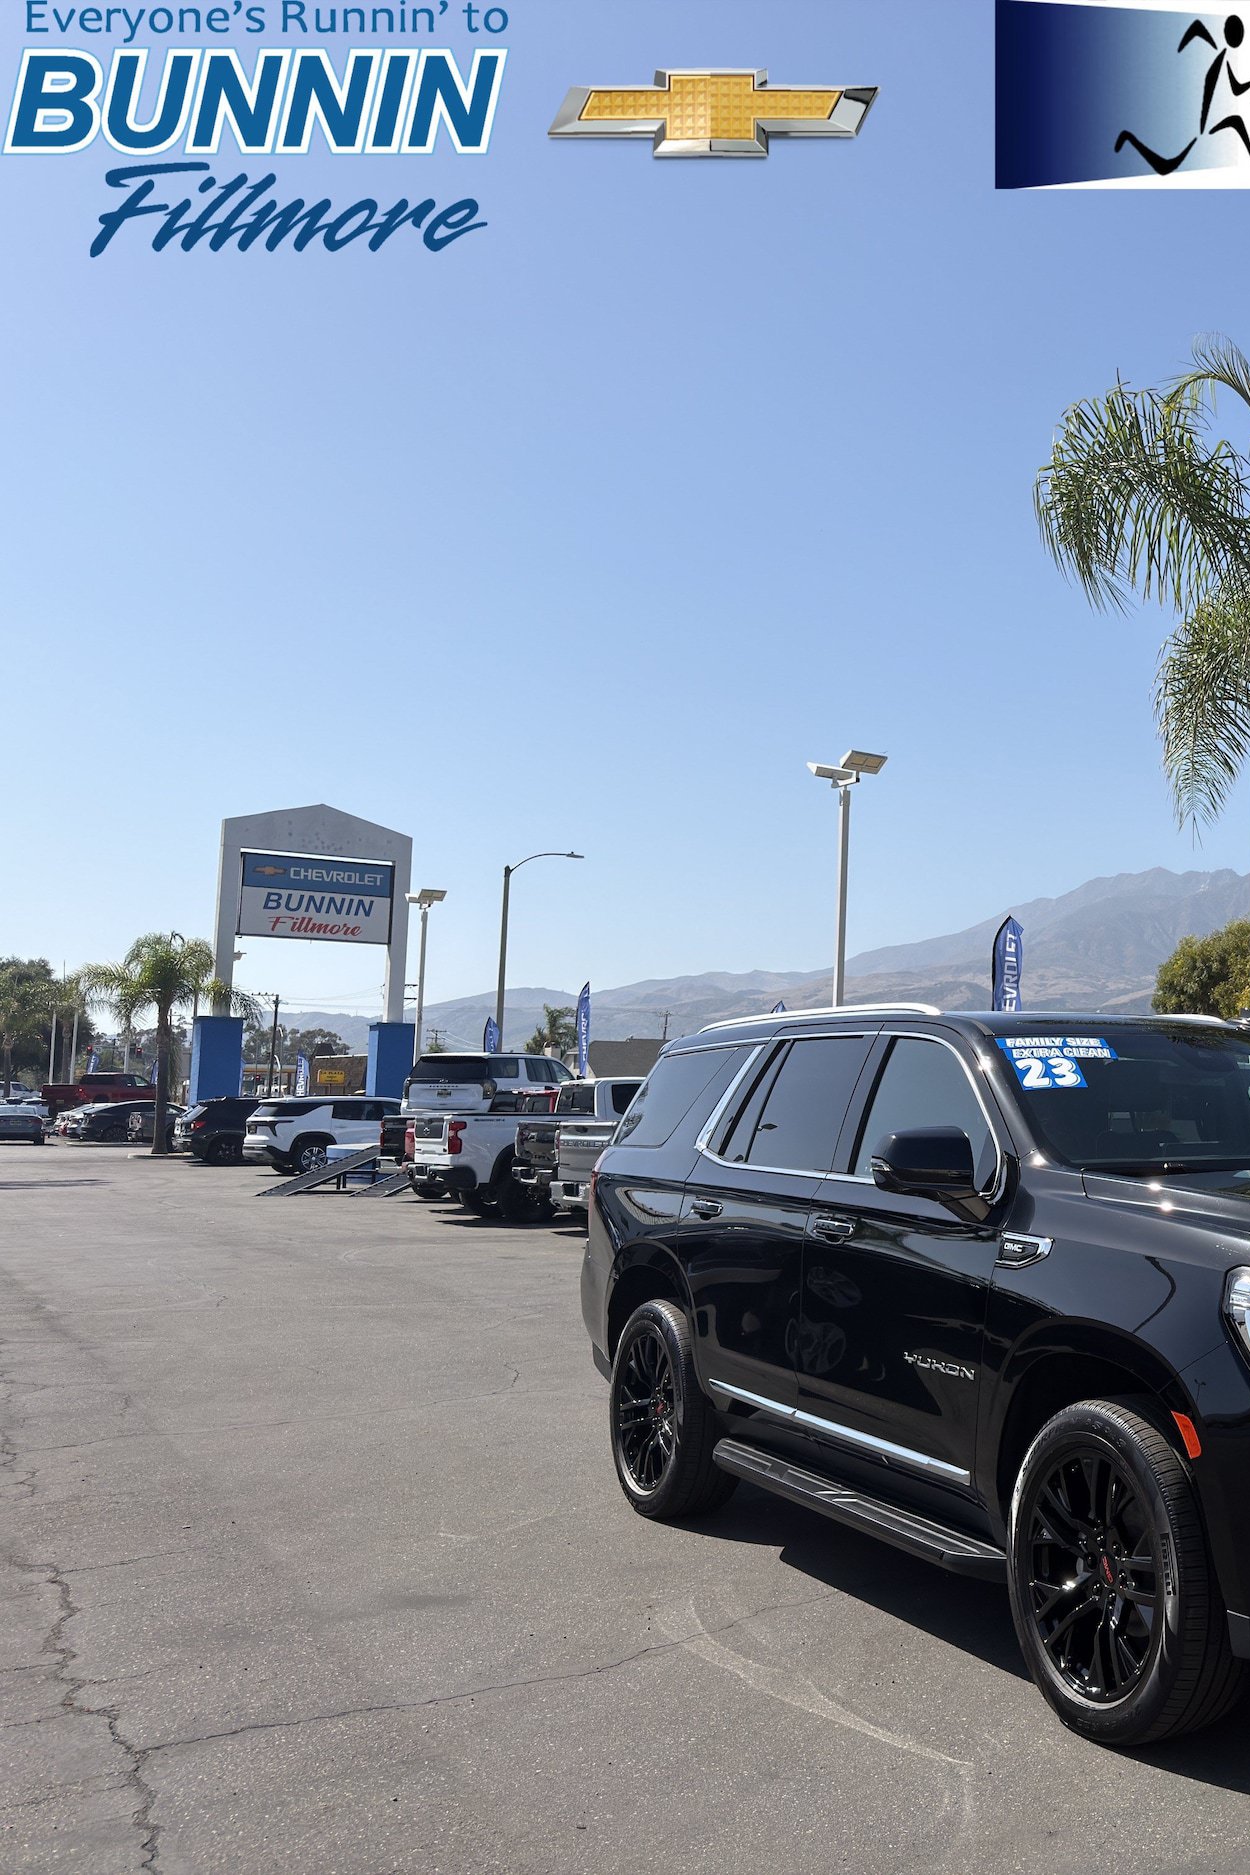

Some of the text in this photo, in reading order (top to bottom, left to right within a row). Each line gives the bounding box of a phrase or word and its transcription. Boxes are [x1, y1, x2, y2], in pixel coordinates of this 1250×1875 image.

[290, 867, 384, 886] CHEVROLET
[263, 892, 375, 917] BUNNIN
[268, 916, 362, 936] Fillmore
[1005, 1037, 1102, 1047] FAMILY SIZE
[1012, 1048, 1112, 1058] EXTRA CLEAN
[1015, 1057, 1081, 1088] 23
[1003, 1242, 1023, 1253] GMC
[903, 1351, 975, 1381] YUKON
